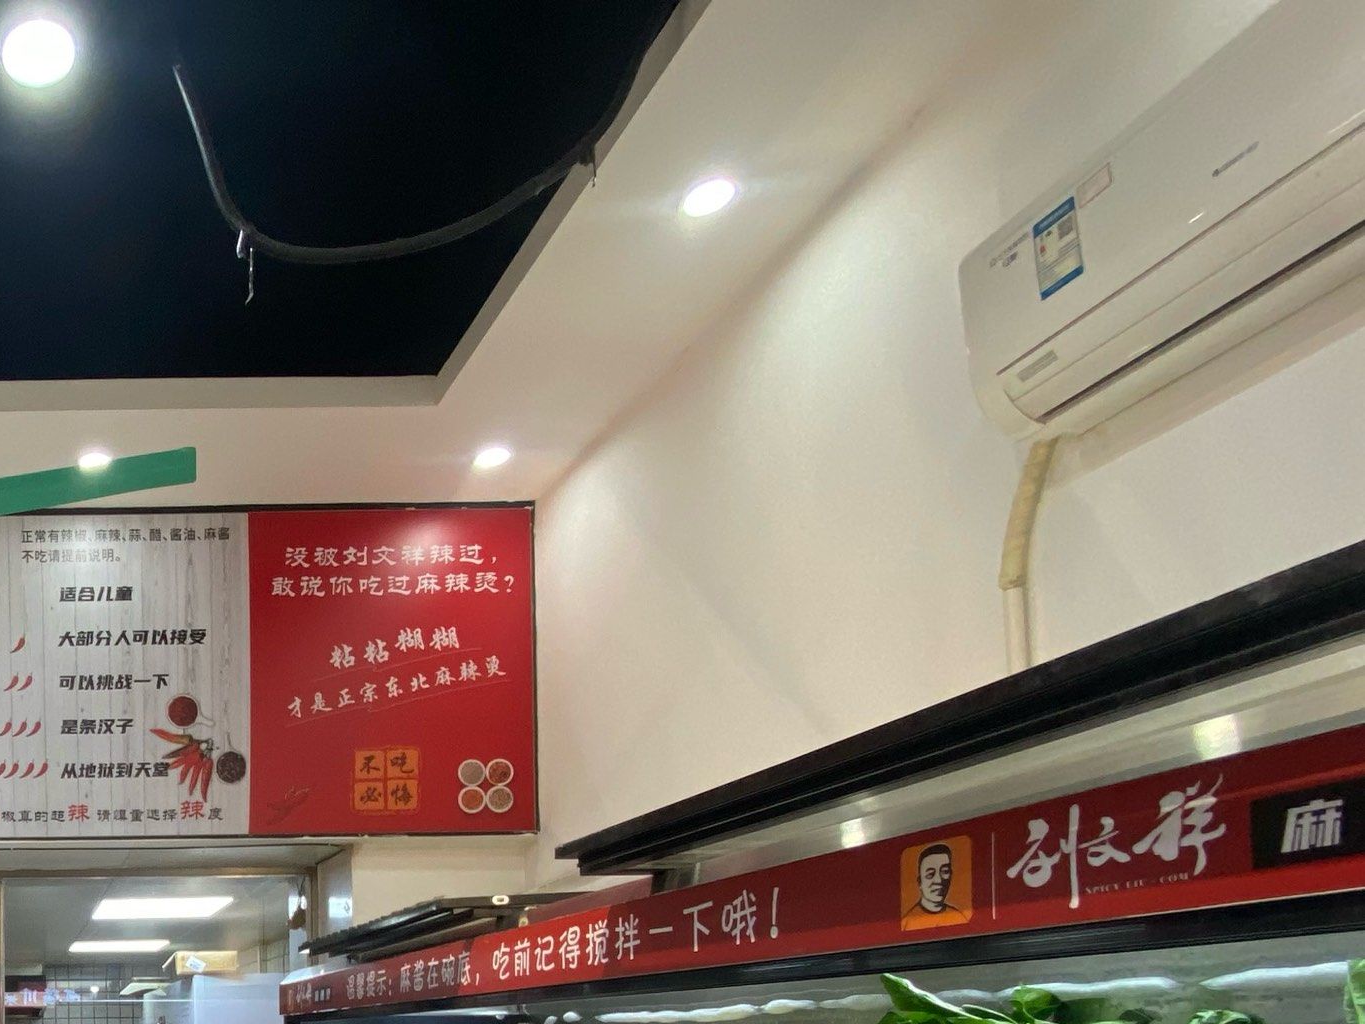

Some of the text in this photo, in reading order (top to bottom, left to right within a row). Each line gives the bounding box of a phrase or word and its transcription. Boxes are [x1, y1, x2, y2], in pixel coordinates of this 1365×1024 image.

[59, 585, 133, 602] 适合儿童
[58, 629, 207, 648] 大部分人可以接受
[330, 626, 460, 670] 粘粘糊糊
[59, 674, 170, 691] 可以挑战一下
[288, 656, 507, 719] 才是正宗东北麻辣烫
[61, 718, 134, 735] 是条汉子
[61, 761, 170, 780] 从地狱到天堂
[1279, 799, 1343, 853] 麻
